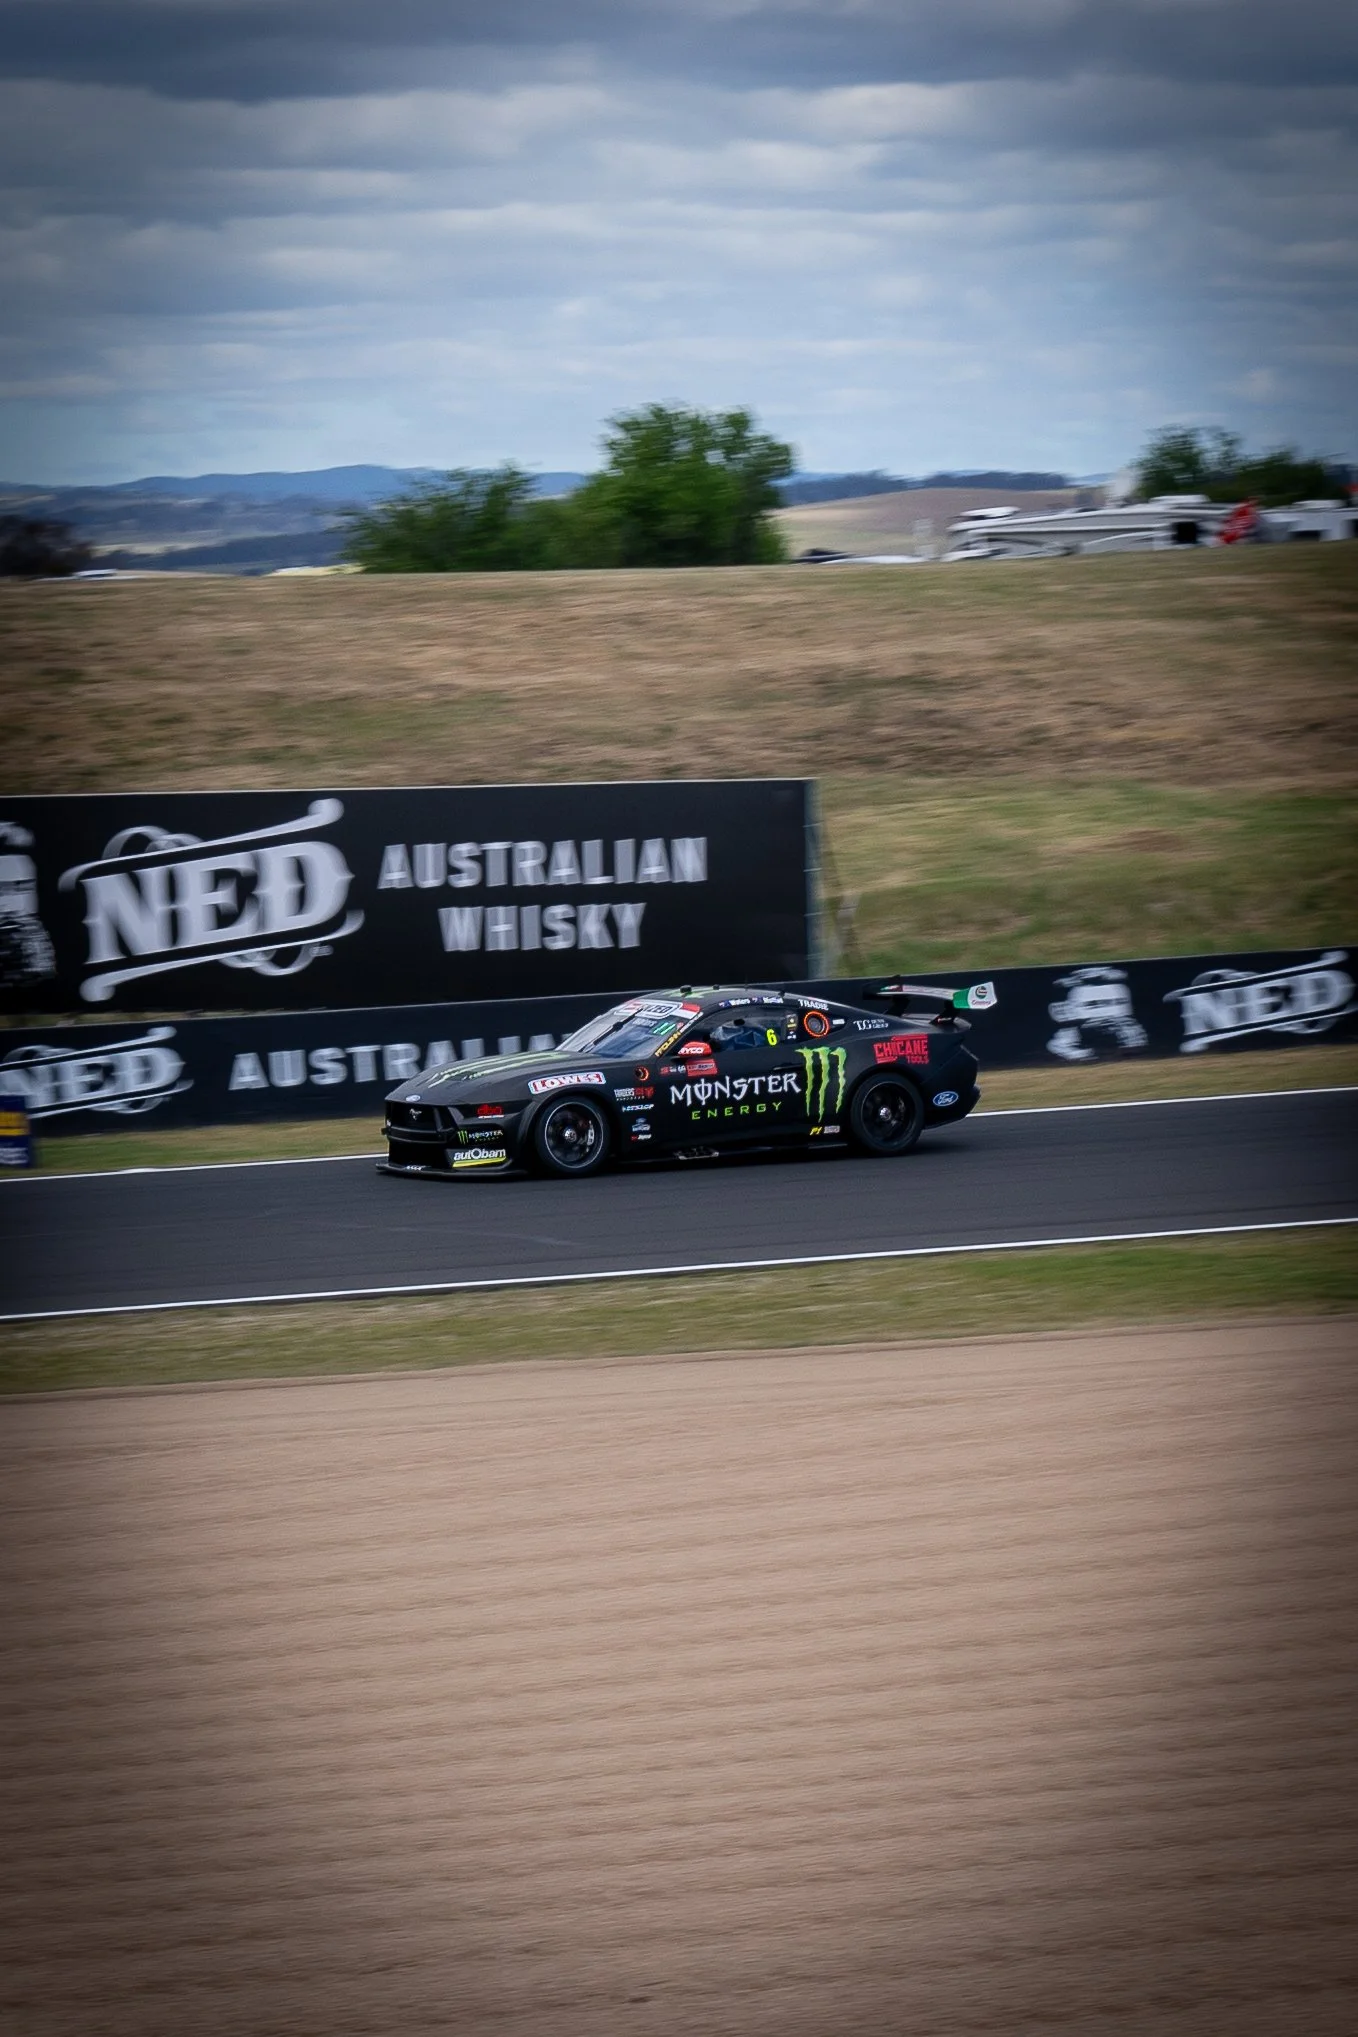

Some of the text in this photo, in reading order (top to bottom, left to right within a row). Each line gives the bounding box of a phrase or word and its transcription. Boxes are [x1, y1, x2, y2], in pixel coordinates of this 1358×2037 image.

[377, 836, 708, 889] AUSTRALIAN
[80, 840, 356, 965] NED
[438, 902, 647, 952] WHISKY
[798, 999, 829, 1011] TRADIE
[1180, 969, 1358, 1035] NED
[766, 1029, 778, 1047] 6
[678, 1046, 705, 1056] RYCO
[873, 1038, 929, 1060] CHICANE
[906, 1055, 930, 1065] TOOLS
[534, 1072, 603, 1093] LOWES
[669, 1072, 802, 1107] MONSTER
[691, 1101, 782, 1120] ENERGY
[468, 1130, 504, 1139] MONSTER
